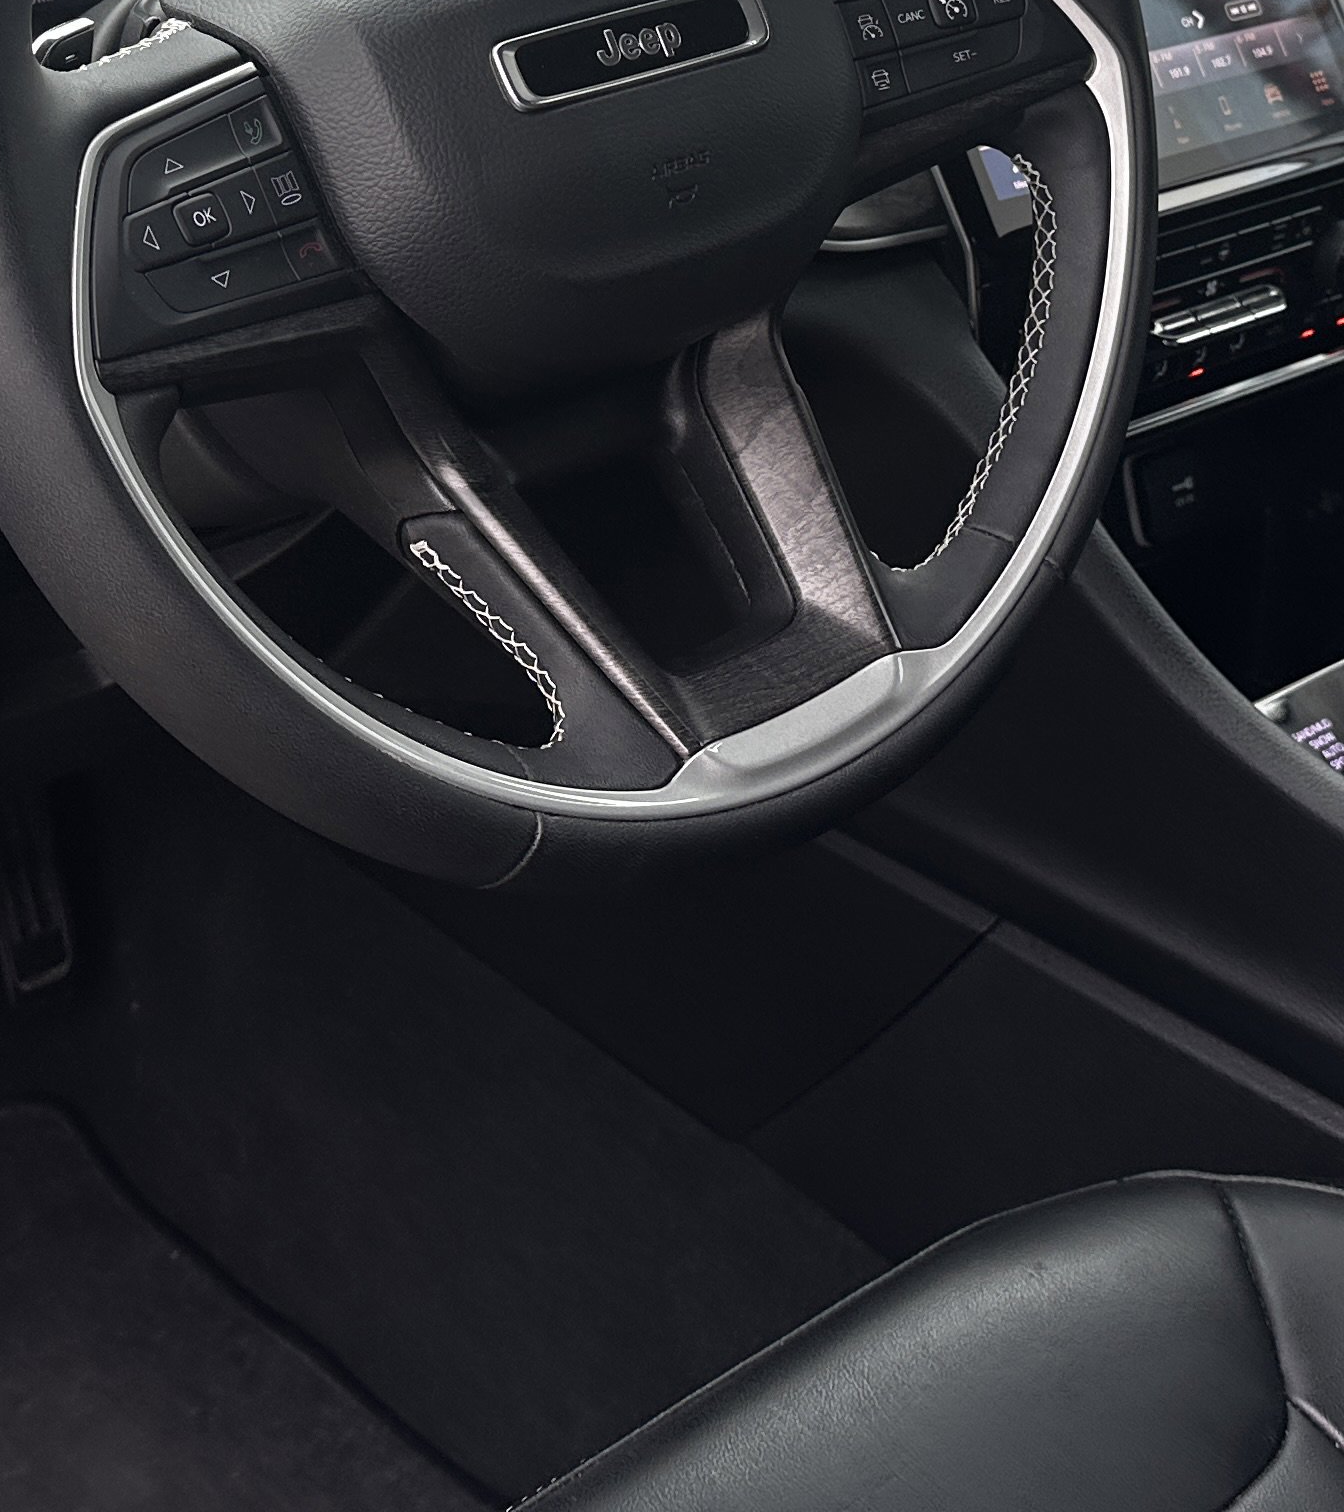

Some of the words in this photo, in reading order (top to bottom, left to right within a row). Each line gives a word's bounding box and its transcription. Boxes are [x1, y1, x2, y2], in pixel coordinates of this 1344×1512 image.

[897, 9, 926, 24] CANC
[596, 21, 682, 66] Jeep
[192, 206, 217, 228] OK
